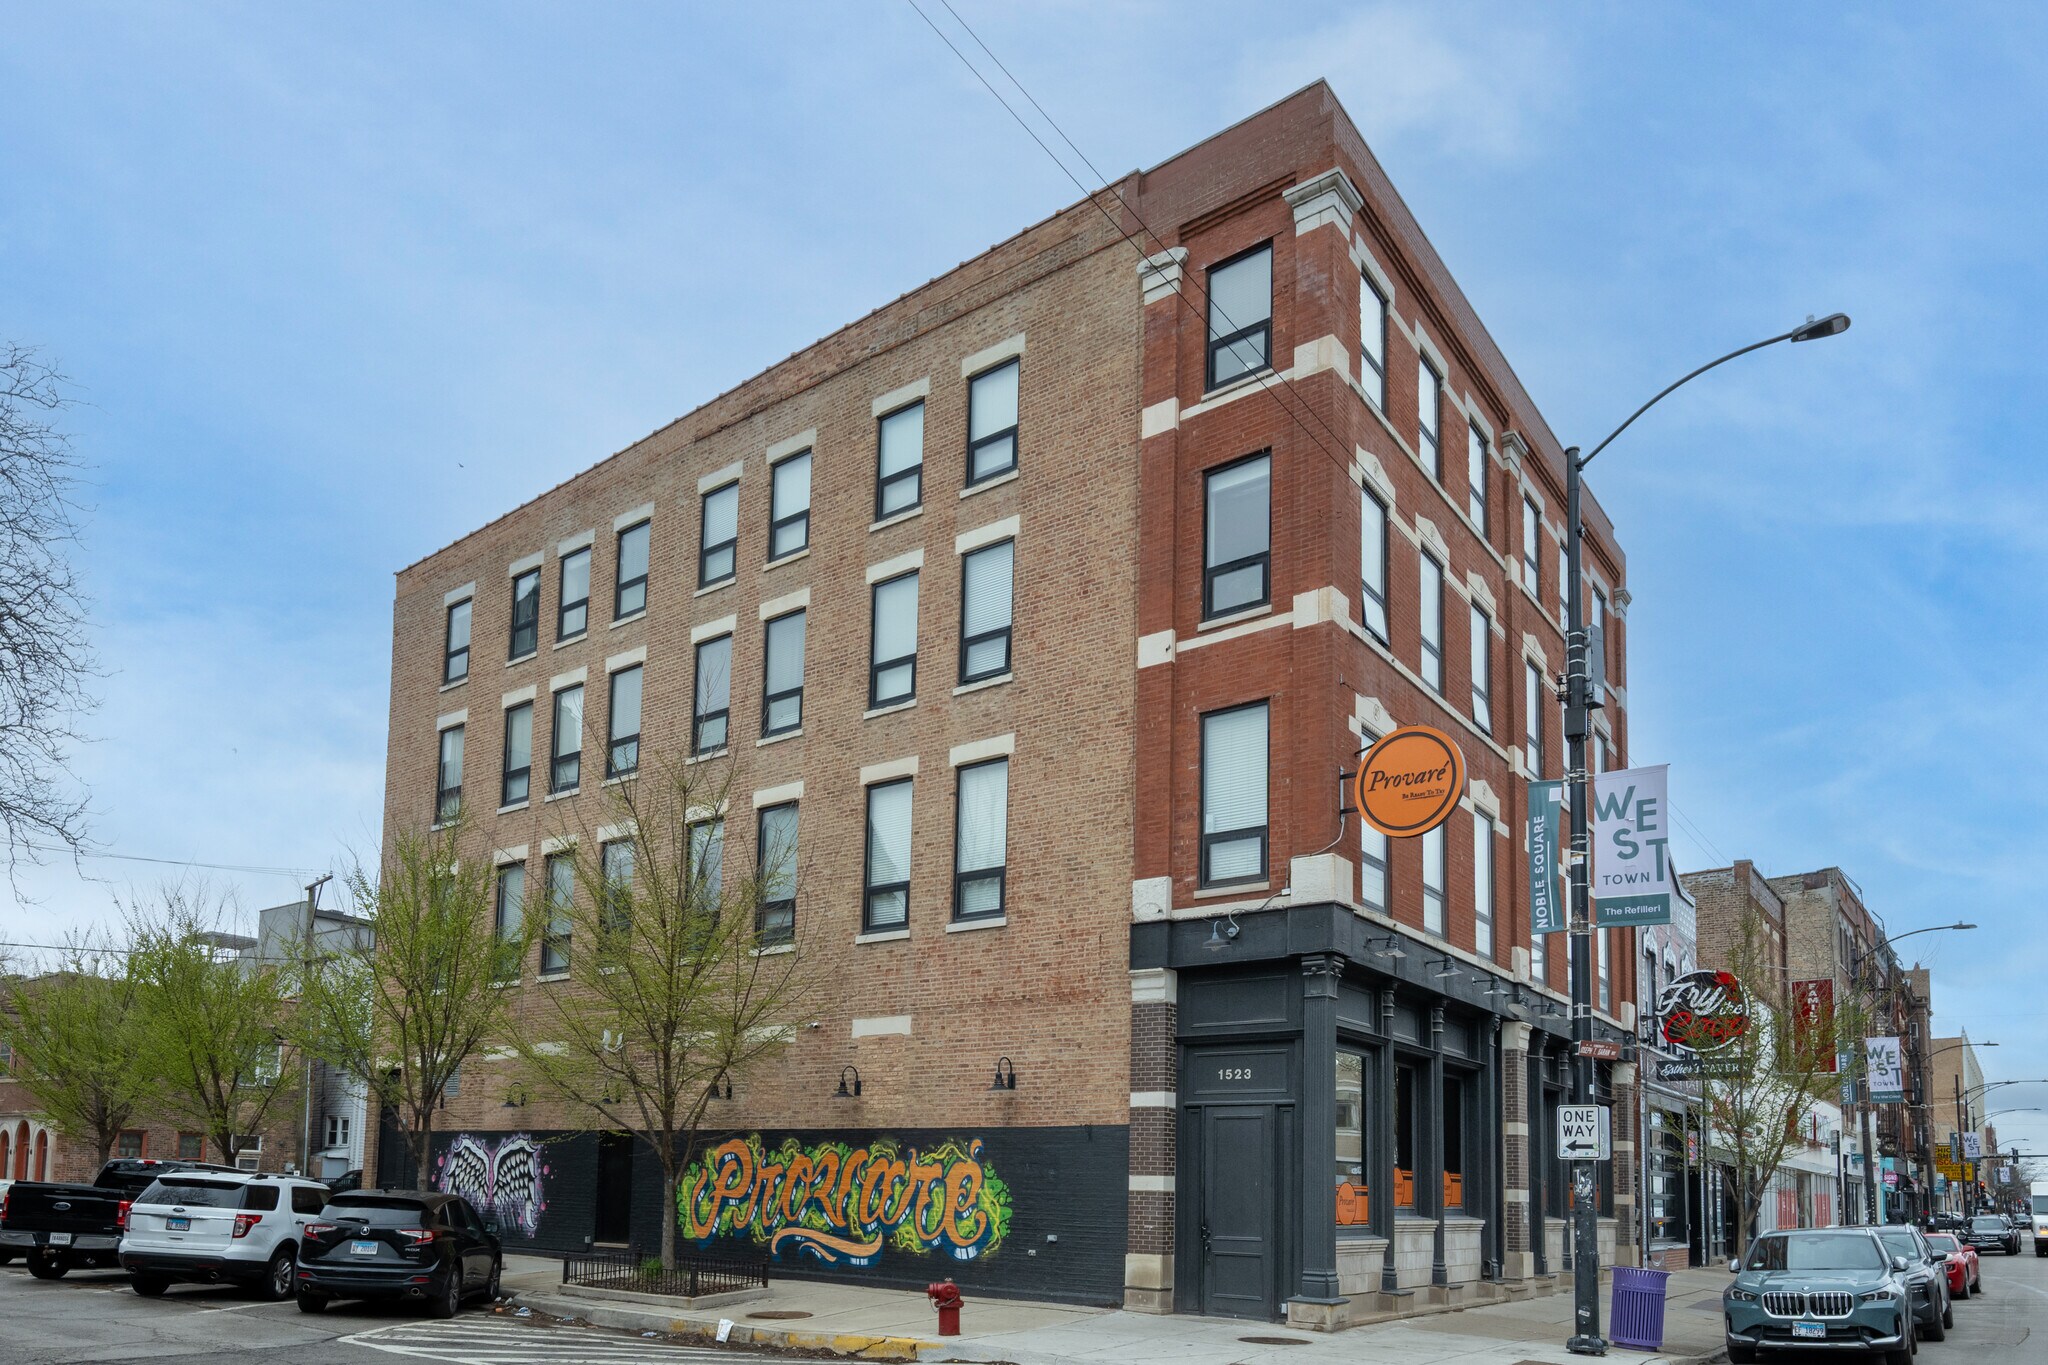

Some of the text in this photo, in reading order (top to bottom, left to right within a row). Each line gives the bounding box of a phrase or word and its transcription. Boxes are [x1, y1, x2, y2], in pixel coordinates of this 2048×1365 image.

[1368, 760, 1449, 792] Provaré
[1534, 815, 1549, 929] NOBLE SQUARE
[1602, 871, 1650, 886] TOWN
[1605, 907, 1623, 916] The
[1655, 981, 1726, 1016] Fry
[1807, 982, 1819, 1025] FAMILY
[1218, 1068, 1252, 1080] 1523
[1660, 1062, 1700, 1077] Esther's
[1563, 1110, 1595, 1122] ONE
[1562, 1125, 1595, 1137] WAY
[1884, 1173, 1898, 1181] SIGNS
